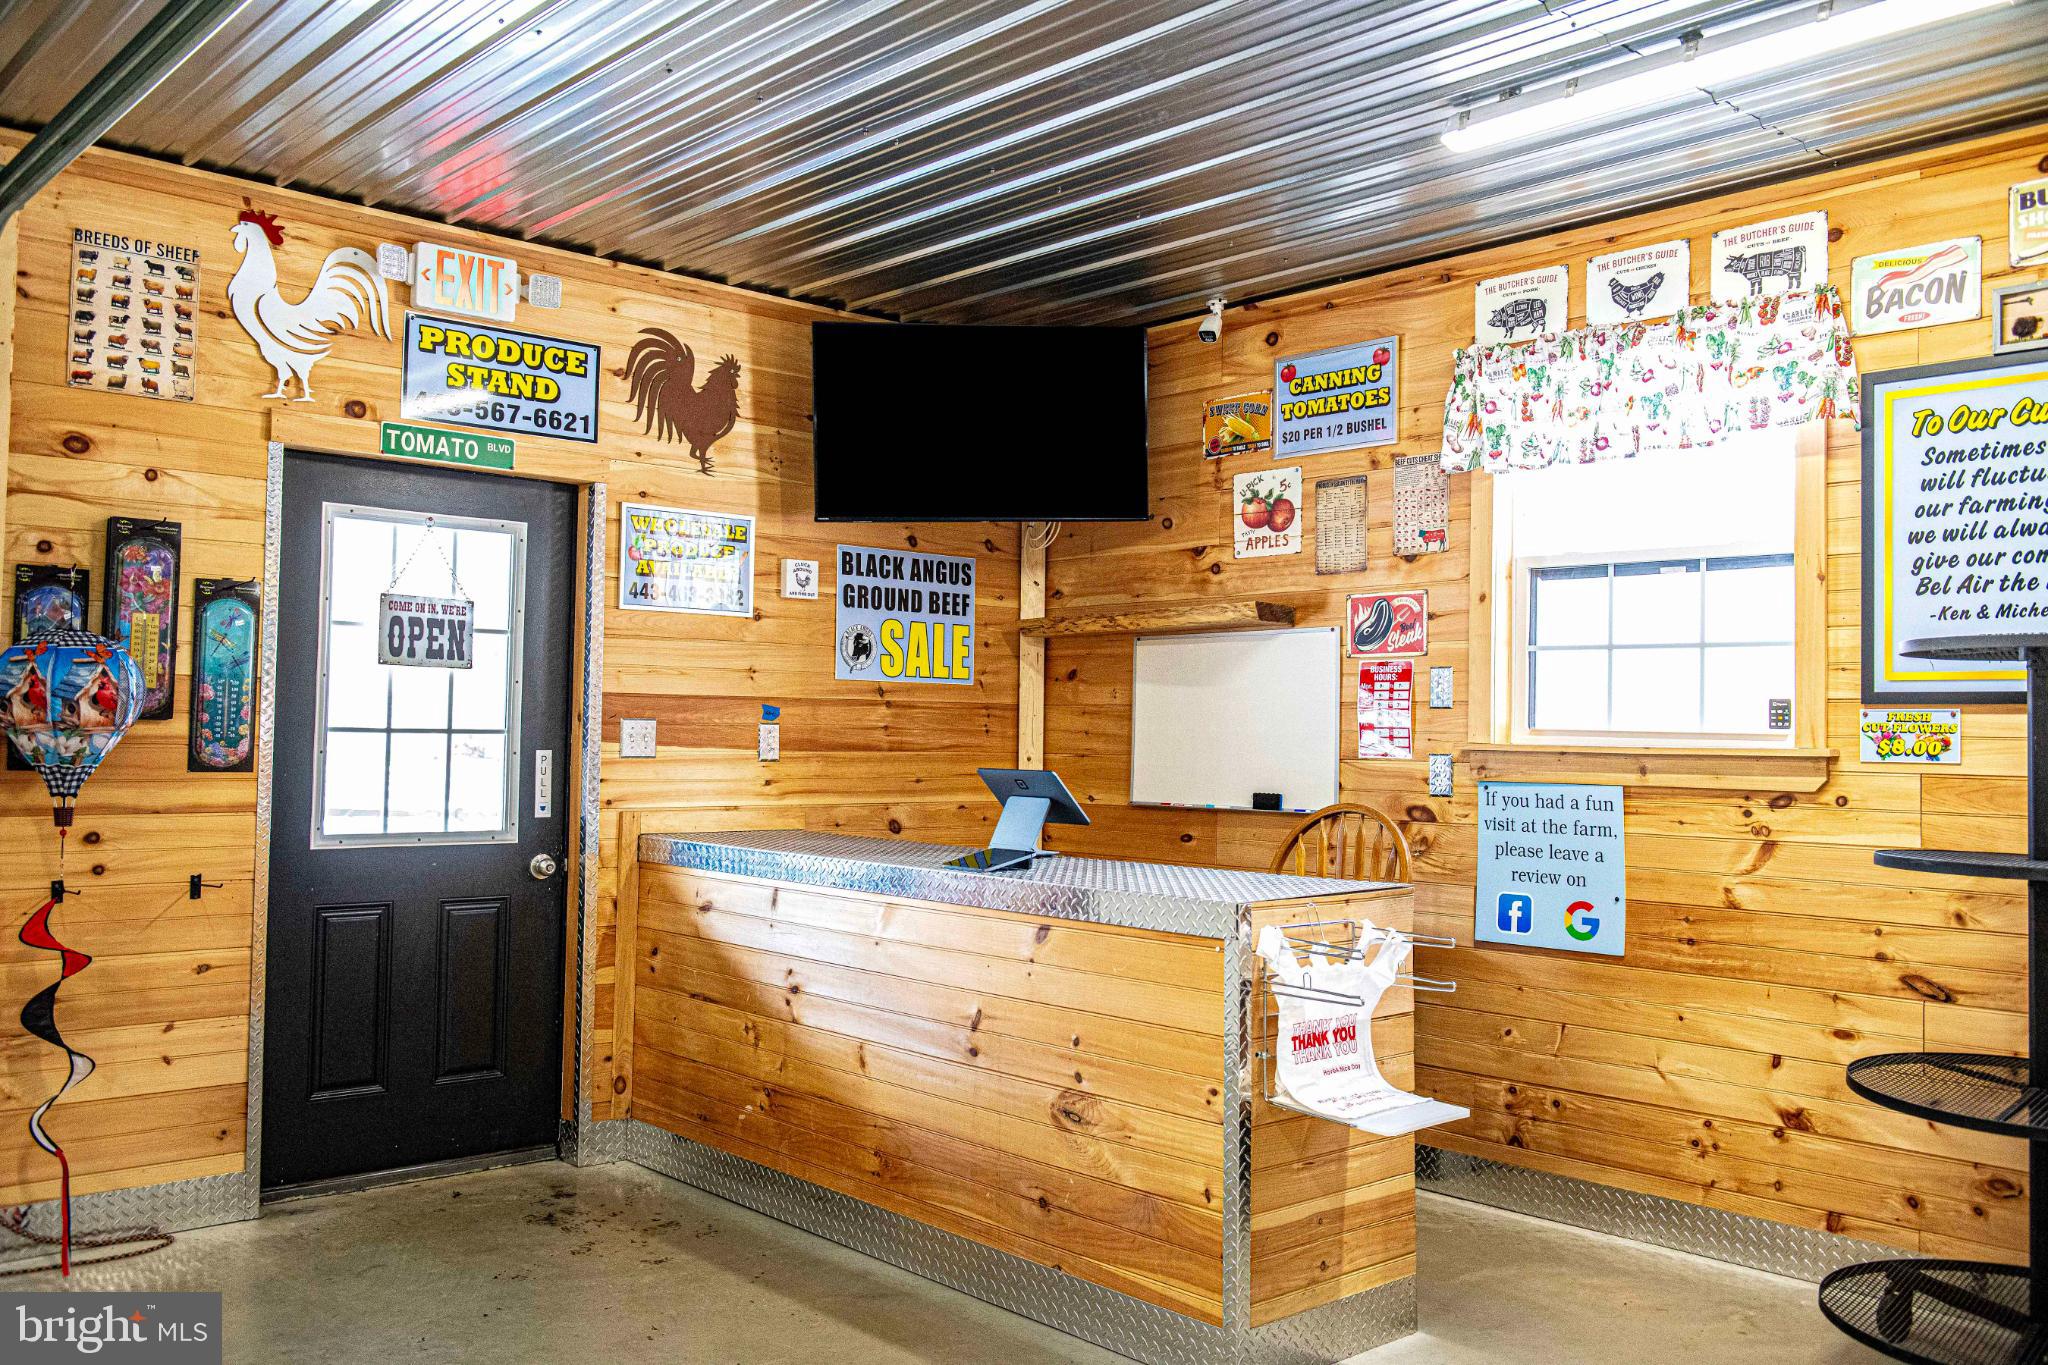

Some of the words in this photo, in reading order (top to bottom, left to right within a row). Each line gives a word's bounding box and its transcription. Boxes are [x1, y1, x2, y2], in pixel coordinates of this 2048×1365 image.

[2018, 210, 2048, 228] SH
[74, 228, 130, 251] BREEDS
[134, 239, 153, 254] OF
[1723, 236, 1738, 247] THE
[1740, 225, 1786, 242] BUTCHER'S
[1789, 222, 1815, 232] GUIDE
[1597, 263, 1610, 272] THE
[1612, 252, 1653, 268] BUTCHER'S
[1655, 249, 1679, 260] GUIDE
[1878, 258, 1922, 269] DELICIOUS
[434, 249, 505, 313] EXIT
[1485, 286, 1497, 296] THE
[1498, 276, 1535, 292] BUTCHER'S
[1537, 274, 1558, 284] GUIDE
[1866, 270, 1968, 319] BACON
[419, 324, 588, 377] PRODUCE
[446, 362, 560, 404] STAND
[1288, 363, 1382, 395] CANNING
[415, 391, 590, 435] 3-567-6621
[1209, 402, 1240, 417] SWEET
[1281, 386, 1391, 421] TOMATOES
[1282, 430, 1300, 444] $20
[1304, 426, 1323, 440] PER
[1326, 424, 1343, 438] 1/2
[1346, 418, 1387, 435] BUSHEL
[1912, 408, 1944, 438] To
[1948, 404, 2008, 434] Our
[387, 429, 479, 460] TOMATO
[487, 442, 511, 454] BLVD
[1920, 440, 2047, 466] Sometimes
[1240, 474, 1265, 497] U-PICK
[1920, 469, 1966, 492] will
[1914, 502, 1954, 518] our
[1246, 534, 1289, 551] APPLES
[1907, 530, 1936, 545] we
[1942, 520, 1988, 542] will
[841, 550, 905, 580] BLACK
[910, 558, 972, 586] ANGUS
[1910, 552, 1960, 576] give
[1966, 551, 2007, 567] our
[1915, 575, 1952, 596] Bel
[1956, 573, 1995, 594] Air
[1999, 571, 2040, 592] the
[388, 600, 413, 612] COME
[415, 602, 427, 613] ON
[427, 603, 439, 615] IN,
[441, 604, 467, 616] WE'RE
[843, 583, 923, 613] GROUND
[928, 591, 971, 617] BEEF
[1929, 605, 1972, 621] -Ken
[1976, 604, 1990, 619] &
[387, 615, 467, 661] OPEN
[879, 618, 971, 680] SALE
[1387, 622, 1424, 652] Steak
[1370, 665, 1403, 673] BUSINESS
[1373, 673, 1398, 681] HOURS:
[1862, 722, 1890, 732] CUT
[1892, 723, 1958, 734] FLOWERS
[1887, 712, 1932, 722] FRESH
[1876, 738, 1942, 756] $8.00
[1485, 791, 1497, 806] If
[1502, 795, 1529, 811] you
[1535, 793, 1564, 810] had
[1570, 799, 1579, 810] a
[1585, 795, 1614, 812] fun
[1484, 816, 1516, 832] visit
[1521, 819, 1537, 834] at
[1542, 818, 1568, 835] the
[1573, 820, 1618, 839] farm,
[1495, 841, 1543, 860] please
[1549, 844, 1589, 862] leave
[1595, 851, 1604, 863] a
[1511, 869, 1562, 885] review
[1566, 874, 1587, 887] on
[1564, 900, 1600, 941] G
[1291, 1030, 1329, 1051] THANK
[1332, 1026, 1356, 1043] YOU
[1292, 1045, 1332, 1065] THANK
[1332, 1039, 1358, 1057] YOU
